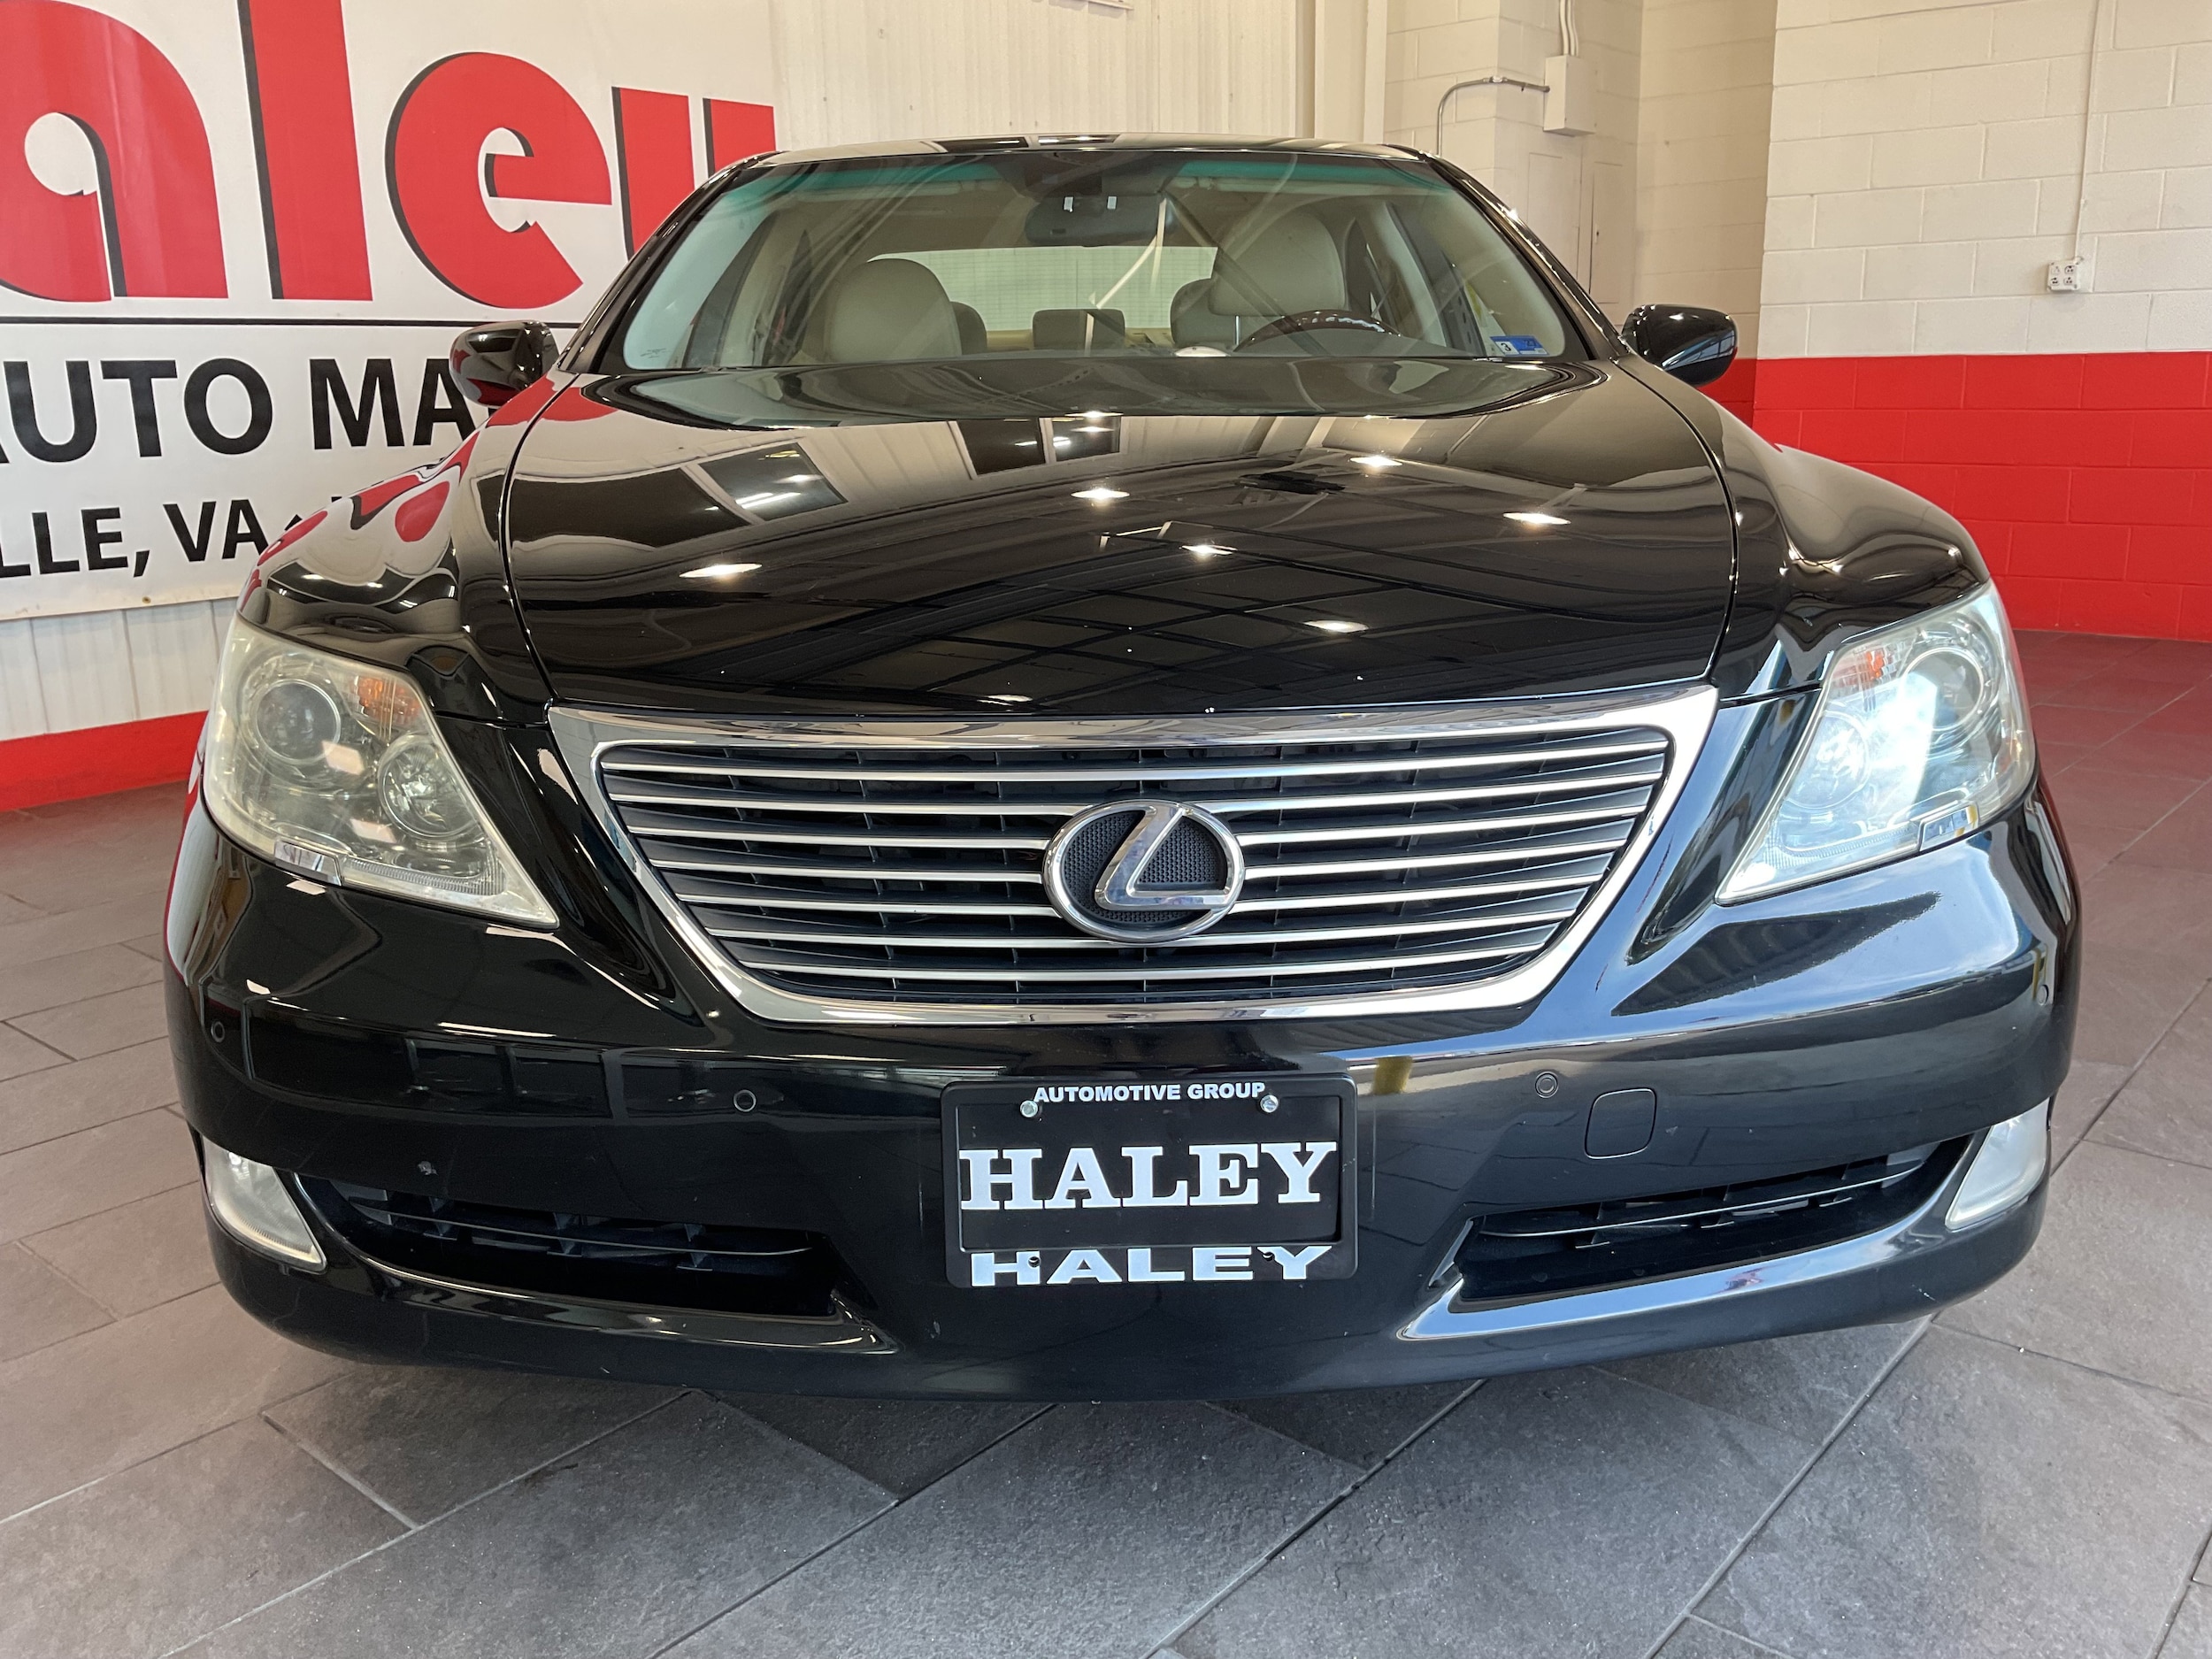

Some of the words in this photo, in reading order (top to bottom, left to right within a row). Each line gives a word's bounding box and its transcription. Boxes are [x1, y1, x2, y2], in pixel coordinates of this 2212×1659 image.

[0, 357, 273, 464] UTO
[309, 357, 497, 450] MA
[163, 499, 270, 563] VA
[1033, 1085, 1181, 1103] AUTOMOTIVE
[1187, 1081, 1266, 1100] GROUP
[959, 1141, 1337, 1210] HALEY
[971, 1245, 1333, 1287] HALEY
